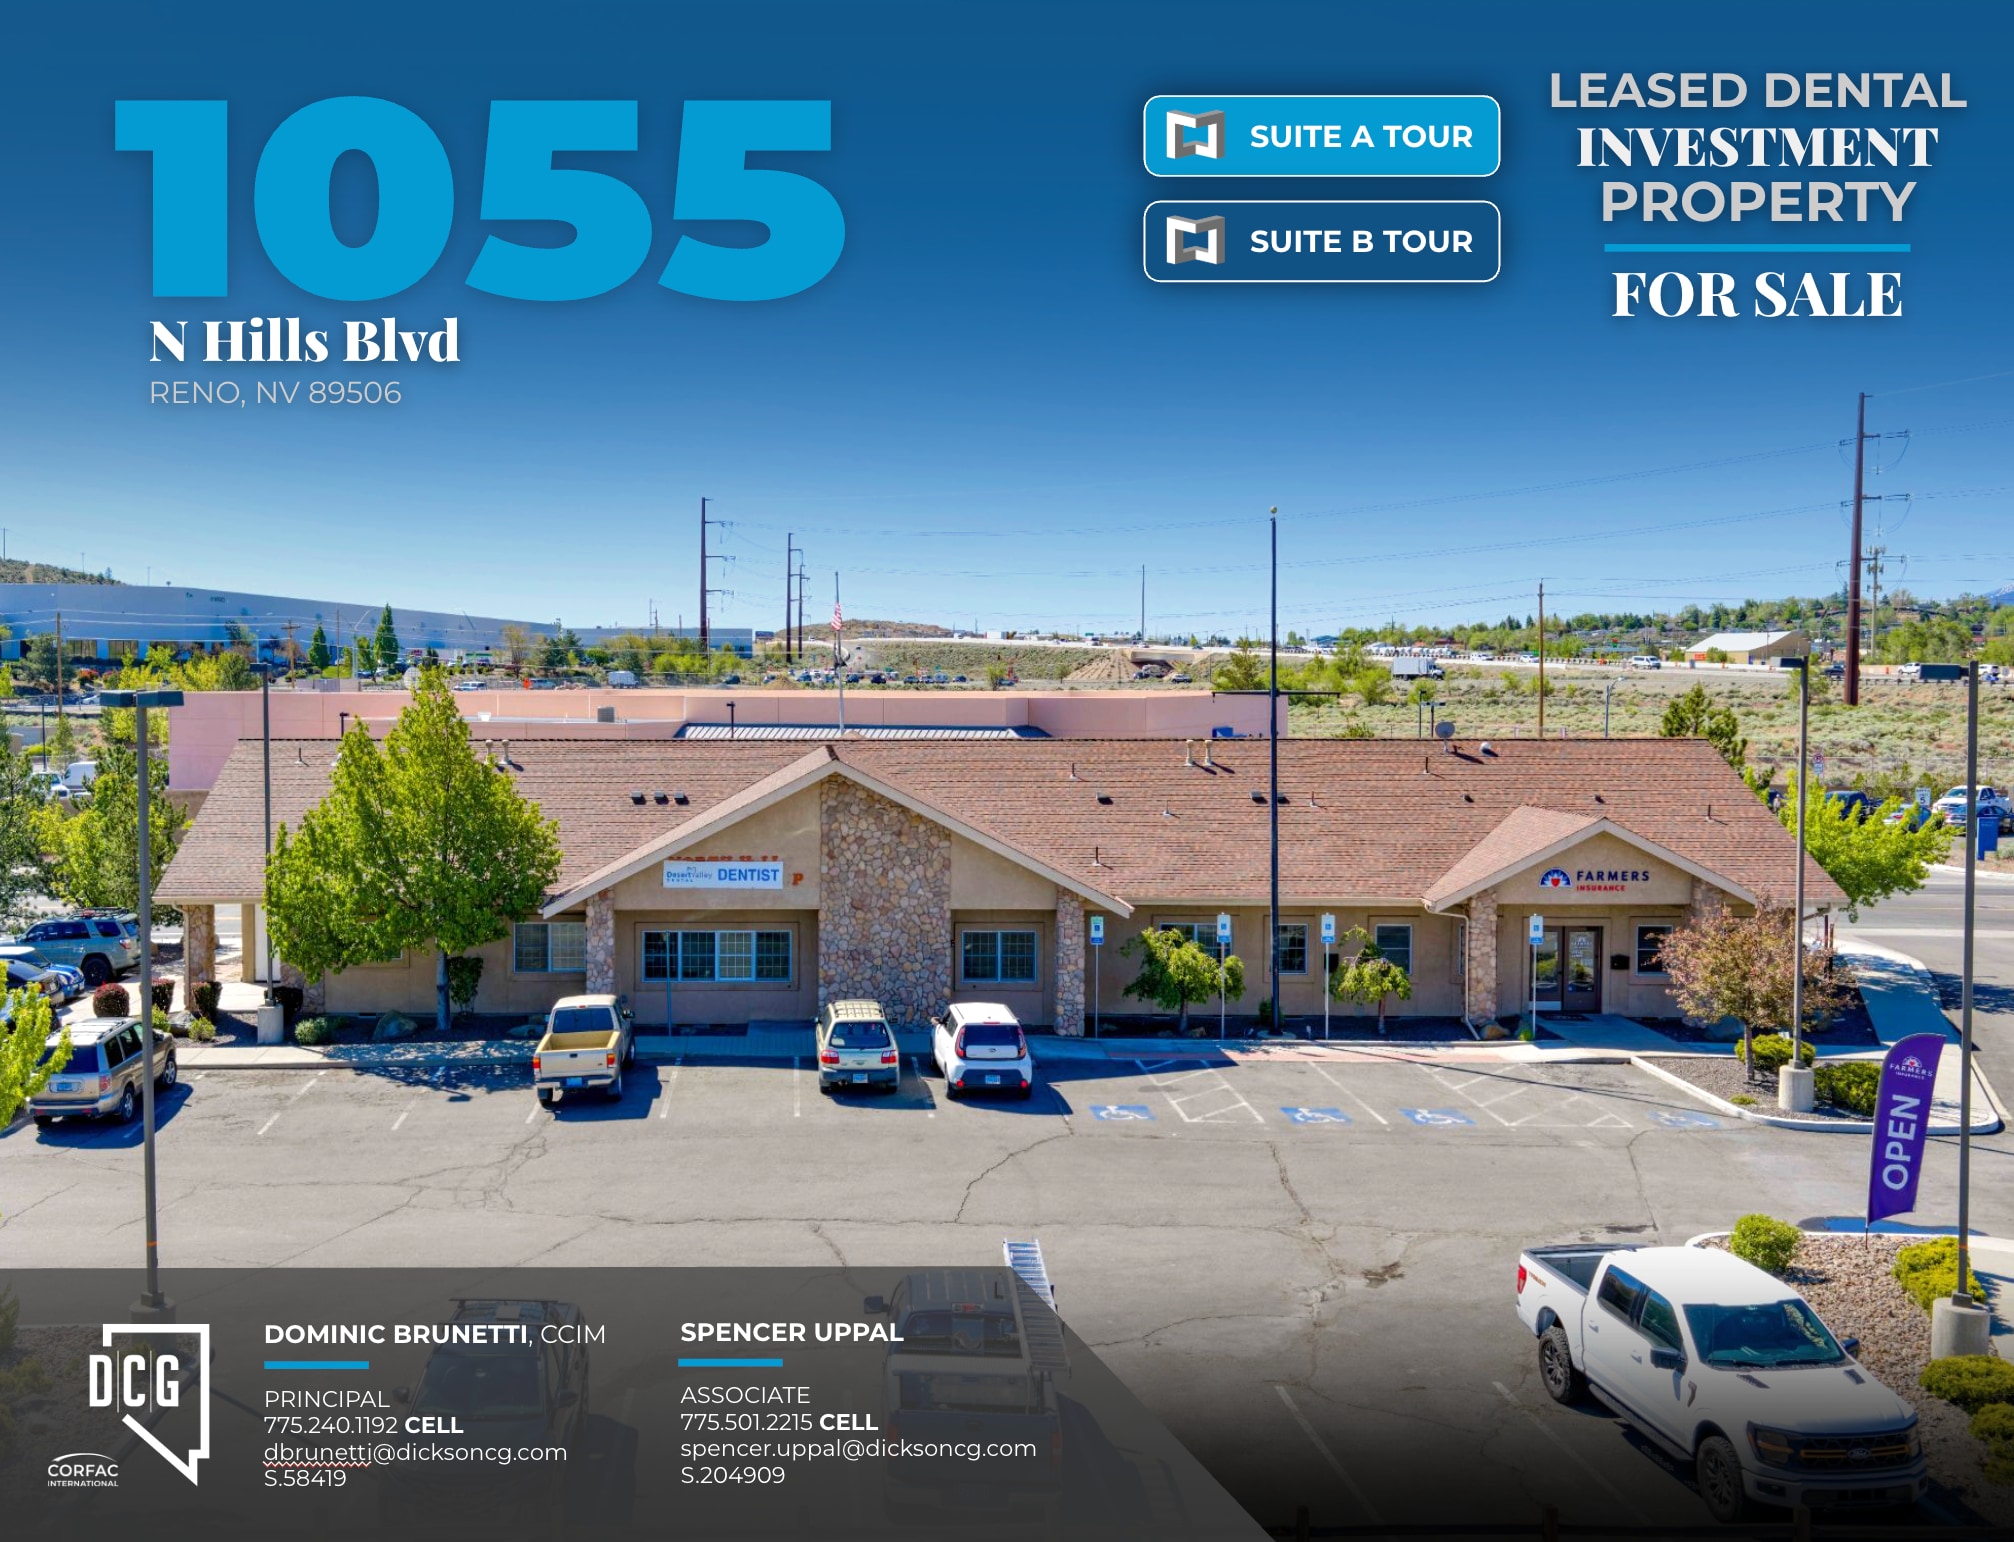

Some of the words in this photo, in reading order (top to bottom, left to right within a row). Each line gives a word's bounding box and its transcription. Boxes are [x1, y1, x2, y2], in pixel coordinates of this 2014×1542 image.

[1919, 796, 1926, 805] 5
[717, 868, 780, 882] DENTIST
[1576, 870, 1650, 882] FARMERS
[1576, 884, 1626, 892] INSURANCE
[1889, 1063, 1933, 1078] FARMERS
[1882, 1094, 1921, 1191] OPEN
